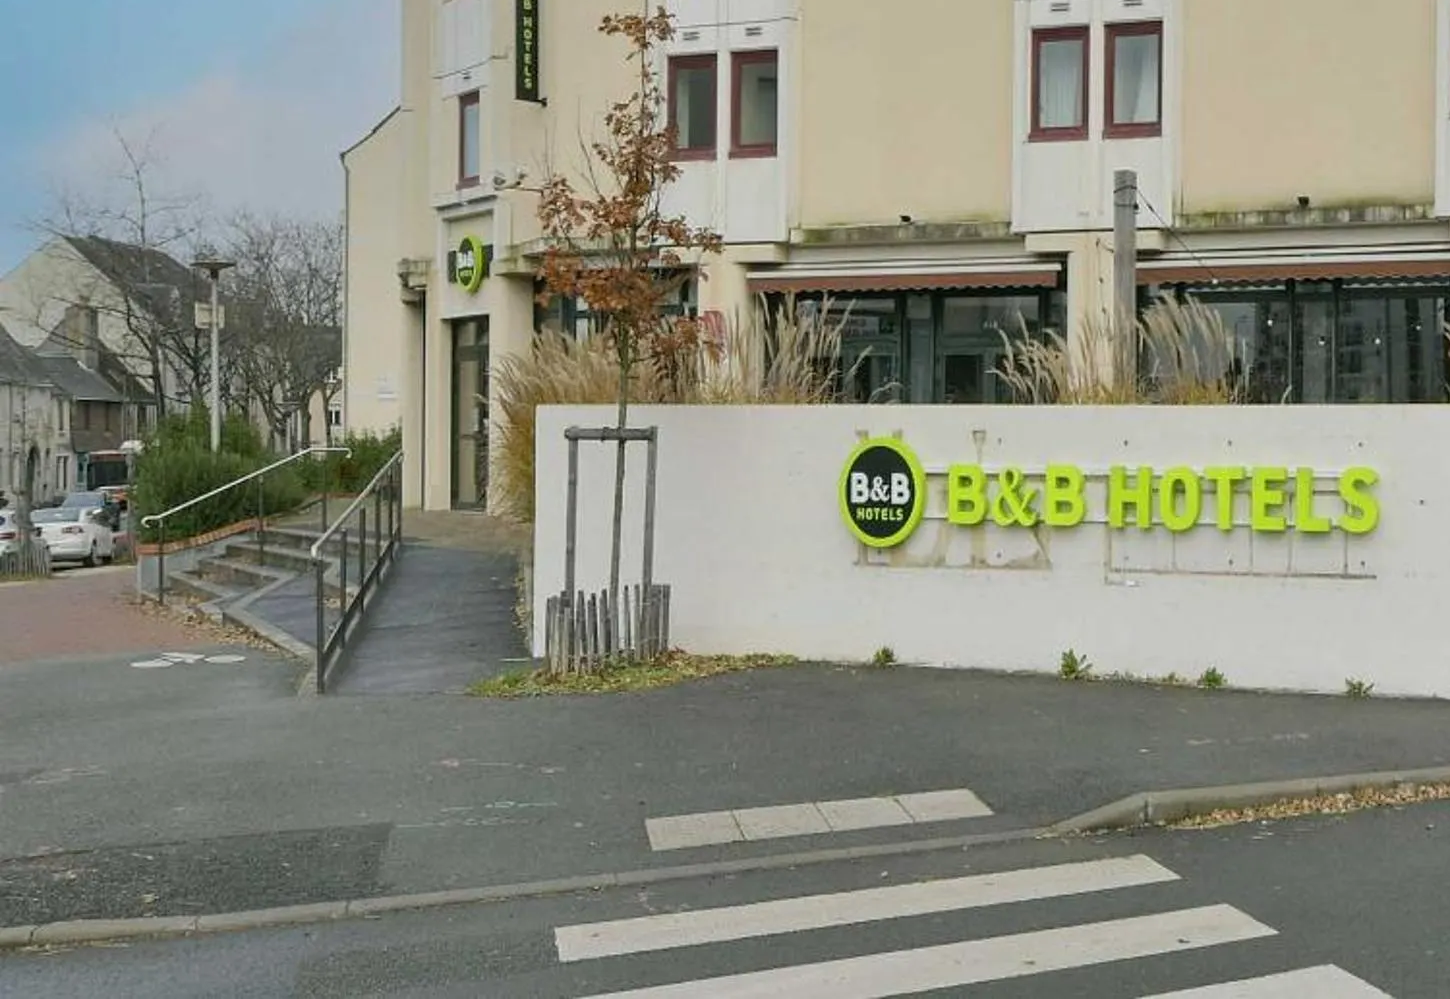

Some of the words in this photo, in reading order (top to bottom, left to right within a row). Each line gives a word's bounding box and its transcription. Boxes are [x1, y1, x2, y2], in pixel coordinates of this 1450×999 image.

[523, 16, 533, 90] HOTELS
[850, 472, 910, 505] B&B
[856, 507, 904, 521] HOTELS
[947, 464, 1086, 527] B&B
[1108, 465, 1381, 534] HOTELS
